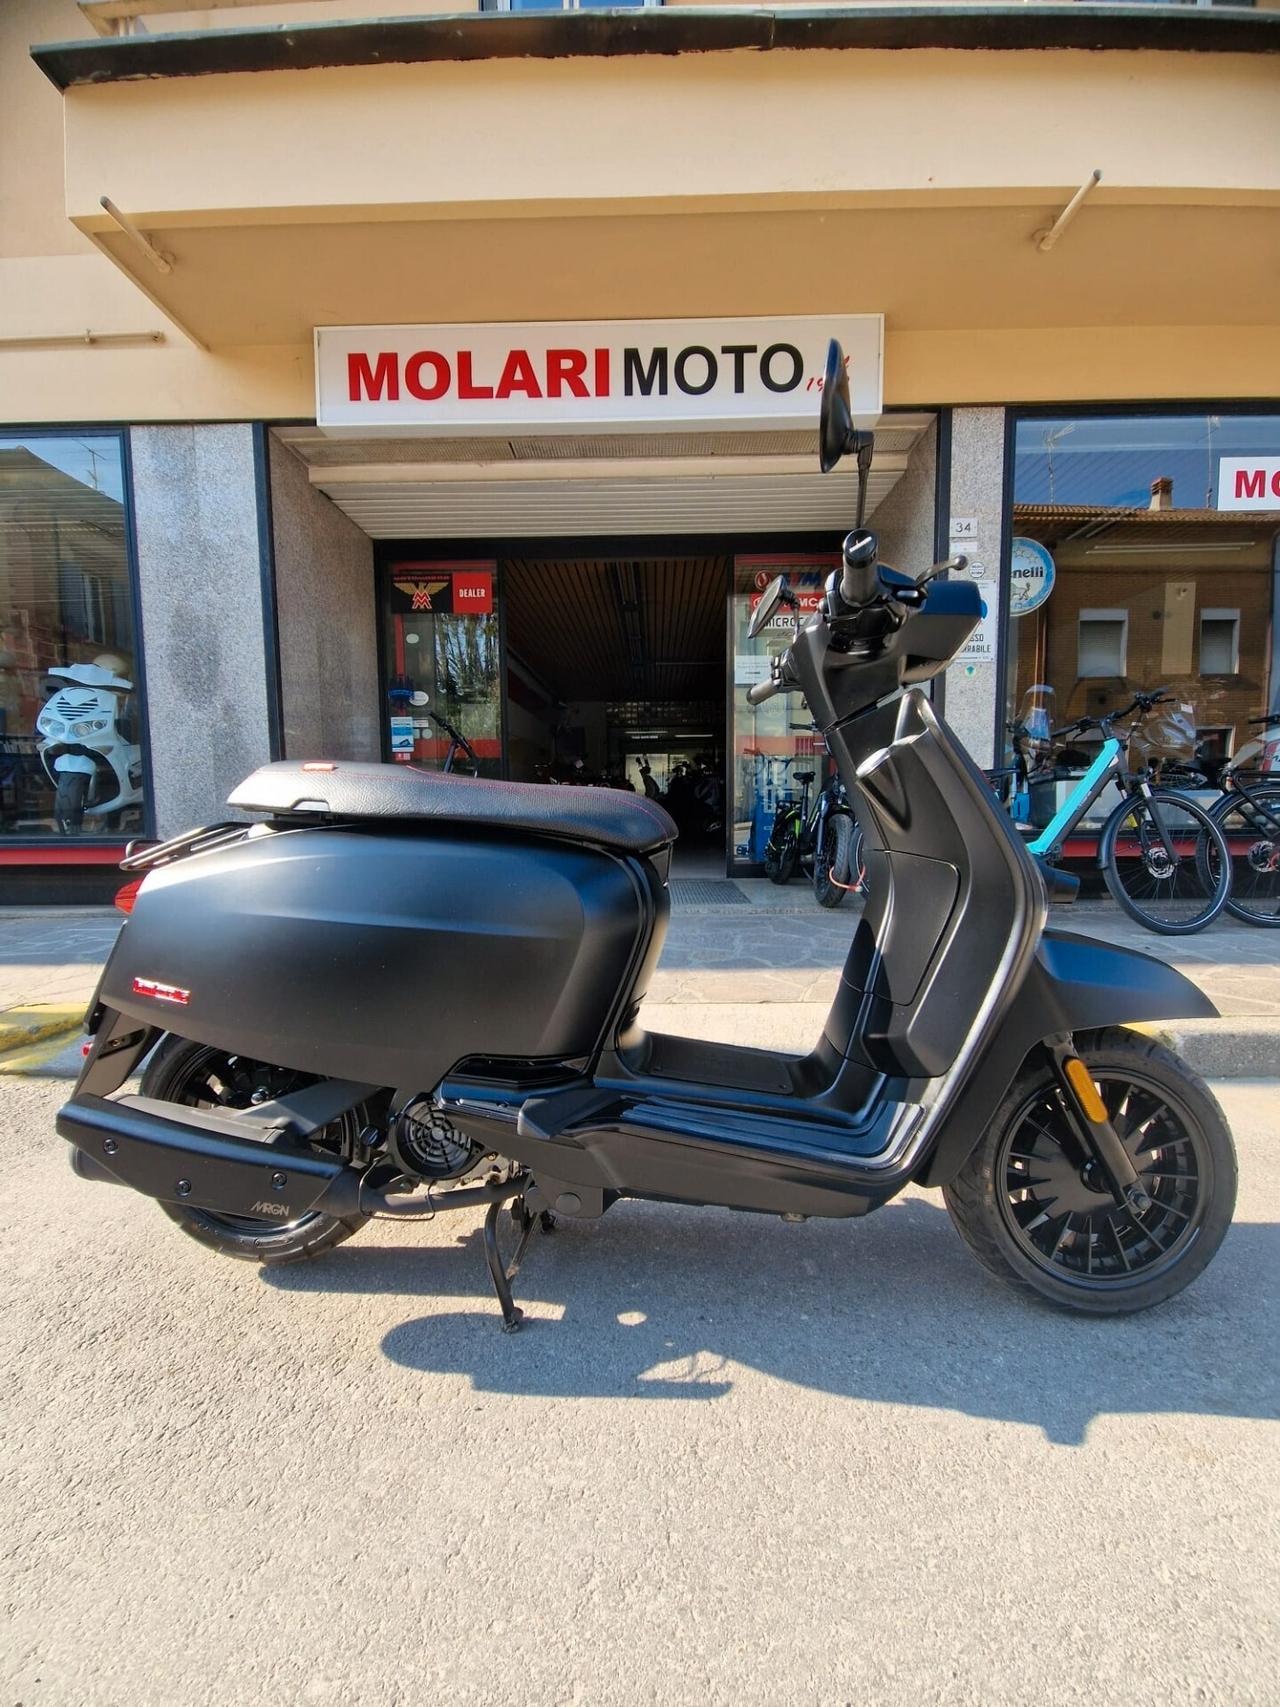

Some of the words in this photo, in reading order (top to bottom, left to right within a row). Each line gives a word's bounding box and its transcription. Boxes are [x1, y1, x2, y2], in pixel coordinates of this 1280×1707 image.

[347, 348, 611, 402] MOLARI
[623, 342, 804, 397] MOTO
[955, 522, 971, 533] 34
[1011, 566, 1044, 578] nelli
[458, 588, 486, 598] DEALER
[250, 1201, 290, 1216] MRGN
